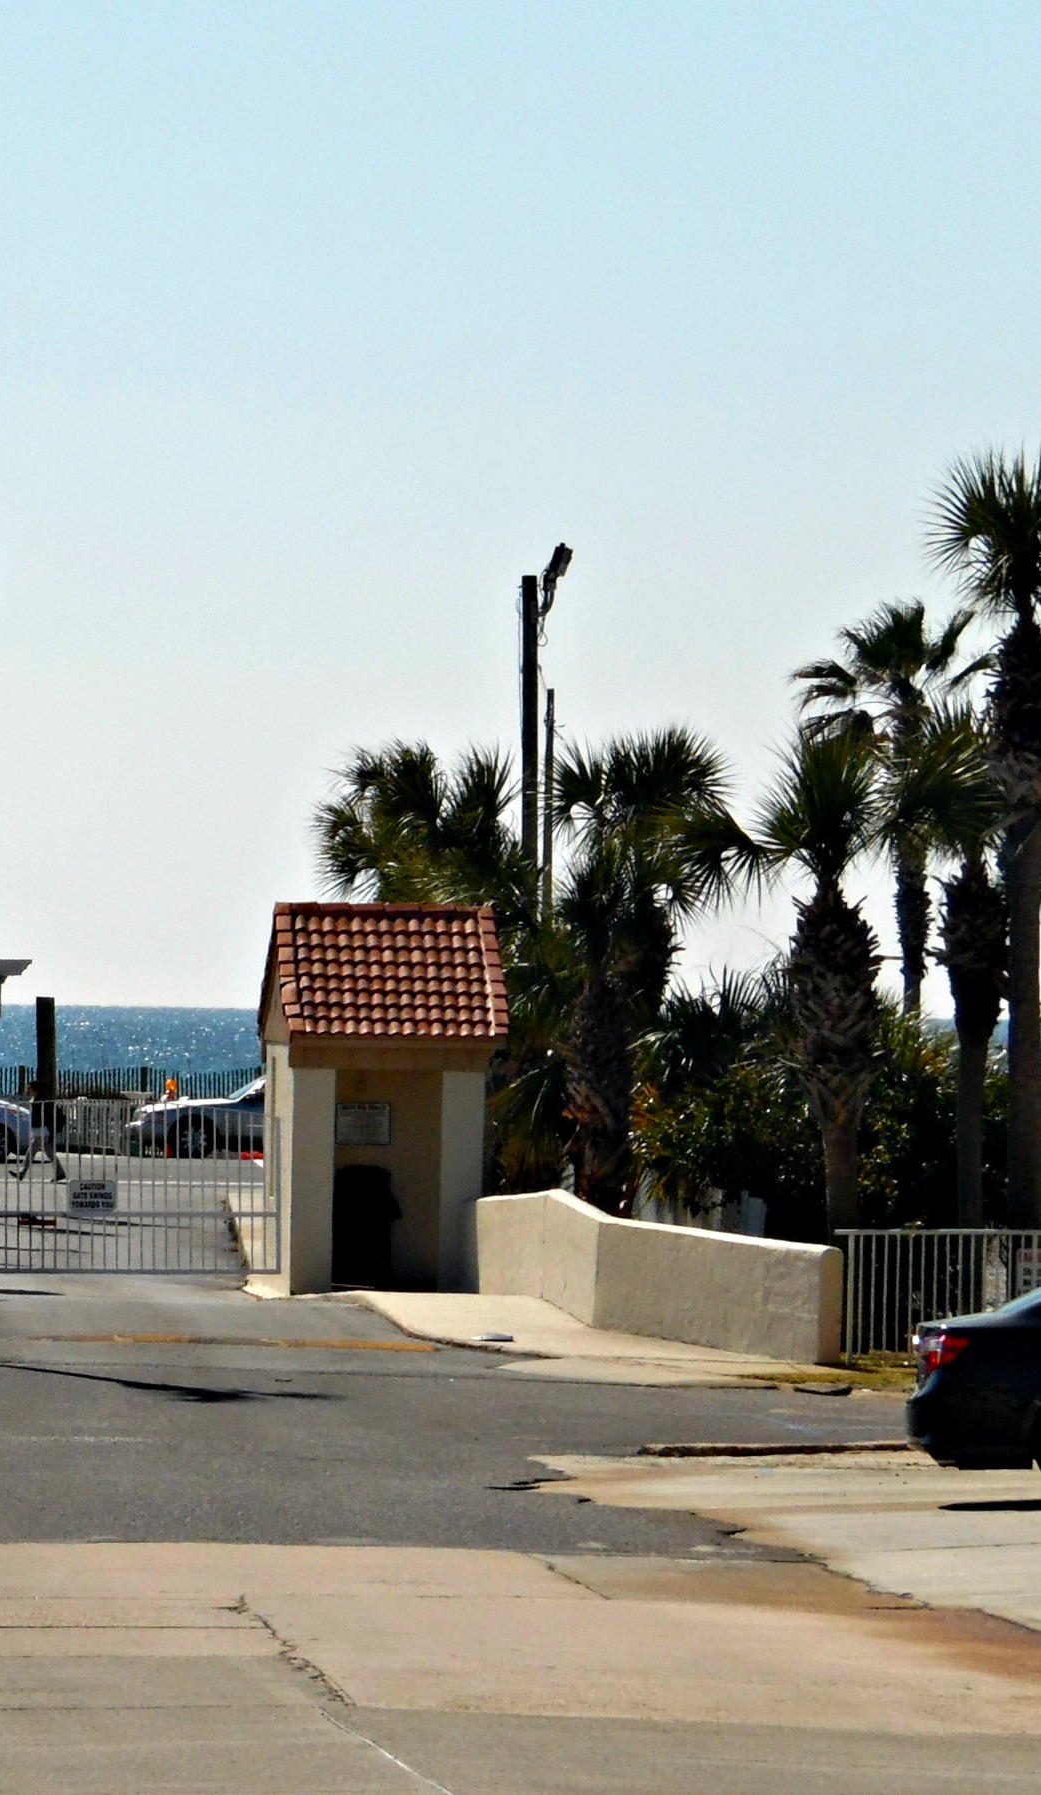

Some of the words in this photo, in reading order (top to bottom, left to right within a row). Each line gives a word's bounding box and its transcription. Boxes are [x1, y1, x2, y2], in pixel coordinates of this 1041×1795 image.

[79, 1182, 105, 1190] CAUTION
[72, 1191, 88, 1199] GATE
[101, 1200, 114, 1208] YOU
